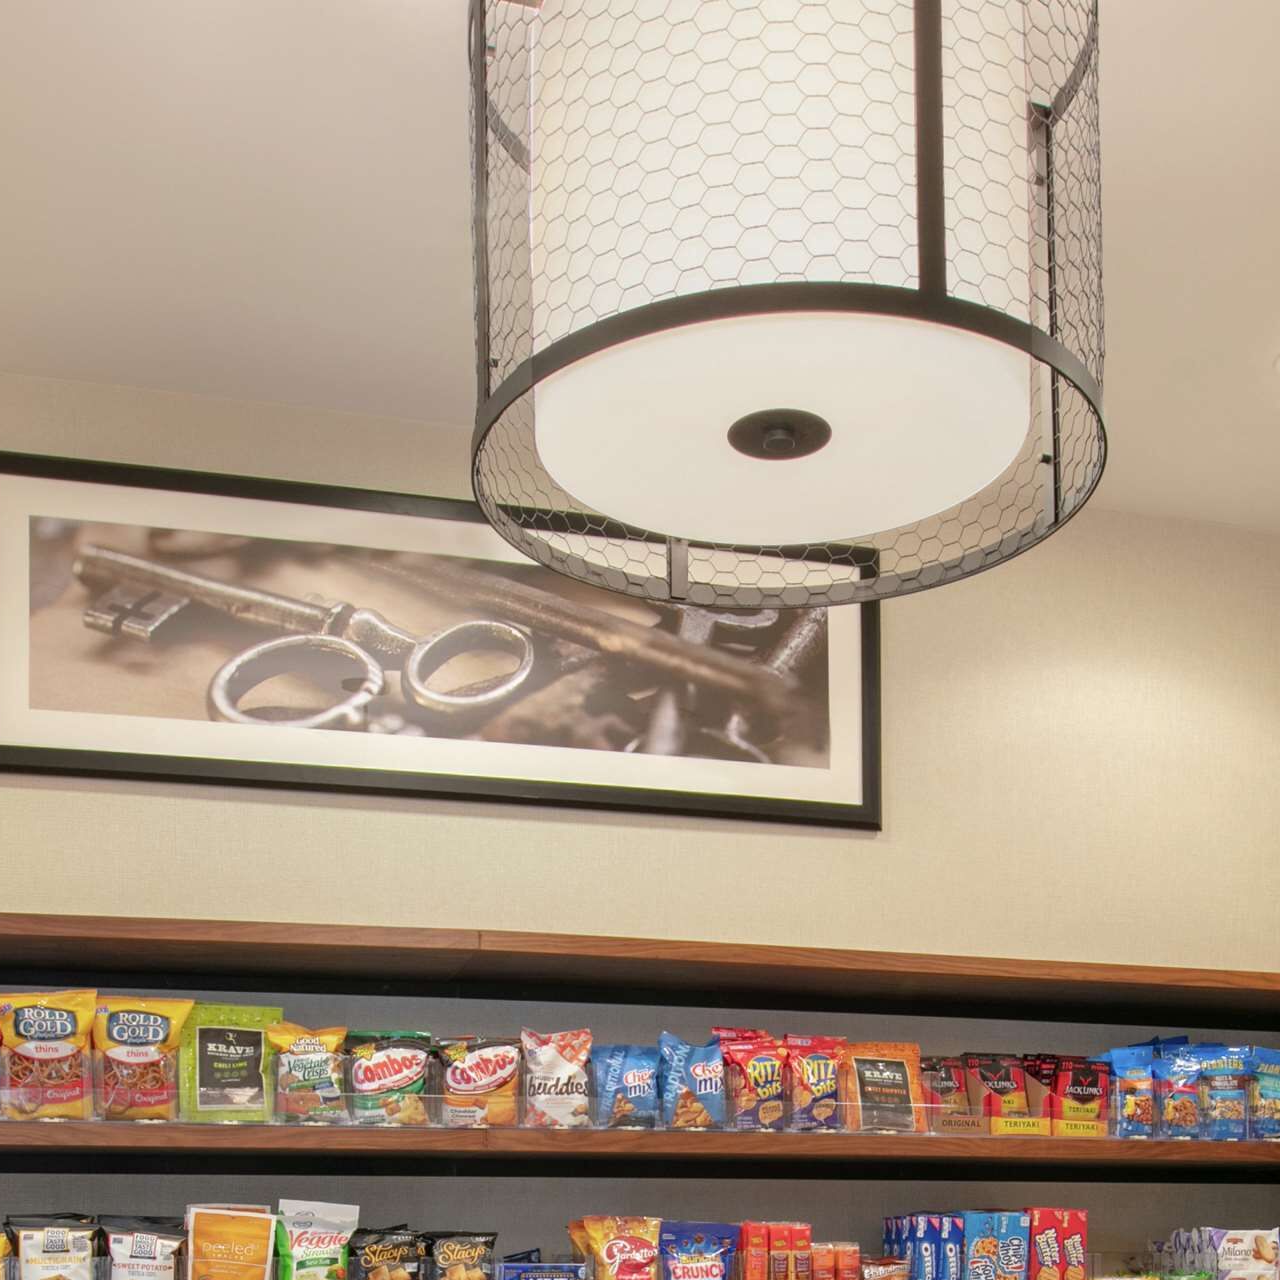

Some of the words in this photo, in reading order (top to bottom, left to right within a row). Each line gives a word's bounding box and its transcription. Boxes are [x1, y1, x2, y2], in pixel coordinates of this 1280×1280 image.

[23, 1006, 69, 1021] ROLD
[118, 1011, 163, 1025] ROLD
[20, 1018, 72, 1037] GOLD
[112, 1024, 164, 1042] GOLD
[34, 1044, 59, 1053] thins
[126, 1049, 149, 1058] thins
[206, 1043, 255, 1054] KRAVE
[353, 1053, 421, 1085] Combos
[749, 1060, 782, 1083] RITZ
[864, 1070, 903, 1081] KRAVE
[527, 1075, 589, 1098] buddies
[942, 1119, 981, 1128] ORIGINAL
[1003, 1120, 1040, 1128] TERIYAKI
[1065, 1122, 1098, 1130] TERIYAKI
[288, 1229, 350, 1249] Veggie
[1044, 1227, 1061, 1264] Nutter
[200, 1239, 254, 1256] peeled
[1034, 1234, 1053, 1268] Butter
[1063, 1238, 1079, 1267] Butter
[1070, 1233, 1085, 1266] Nutter
[1222, 1247, 1252, 1257] Milano
[116, 1263, 140, 1272] SWEET
[140, 1263, 168, 1272] POTATO
